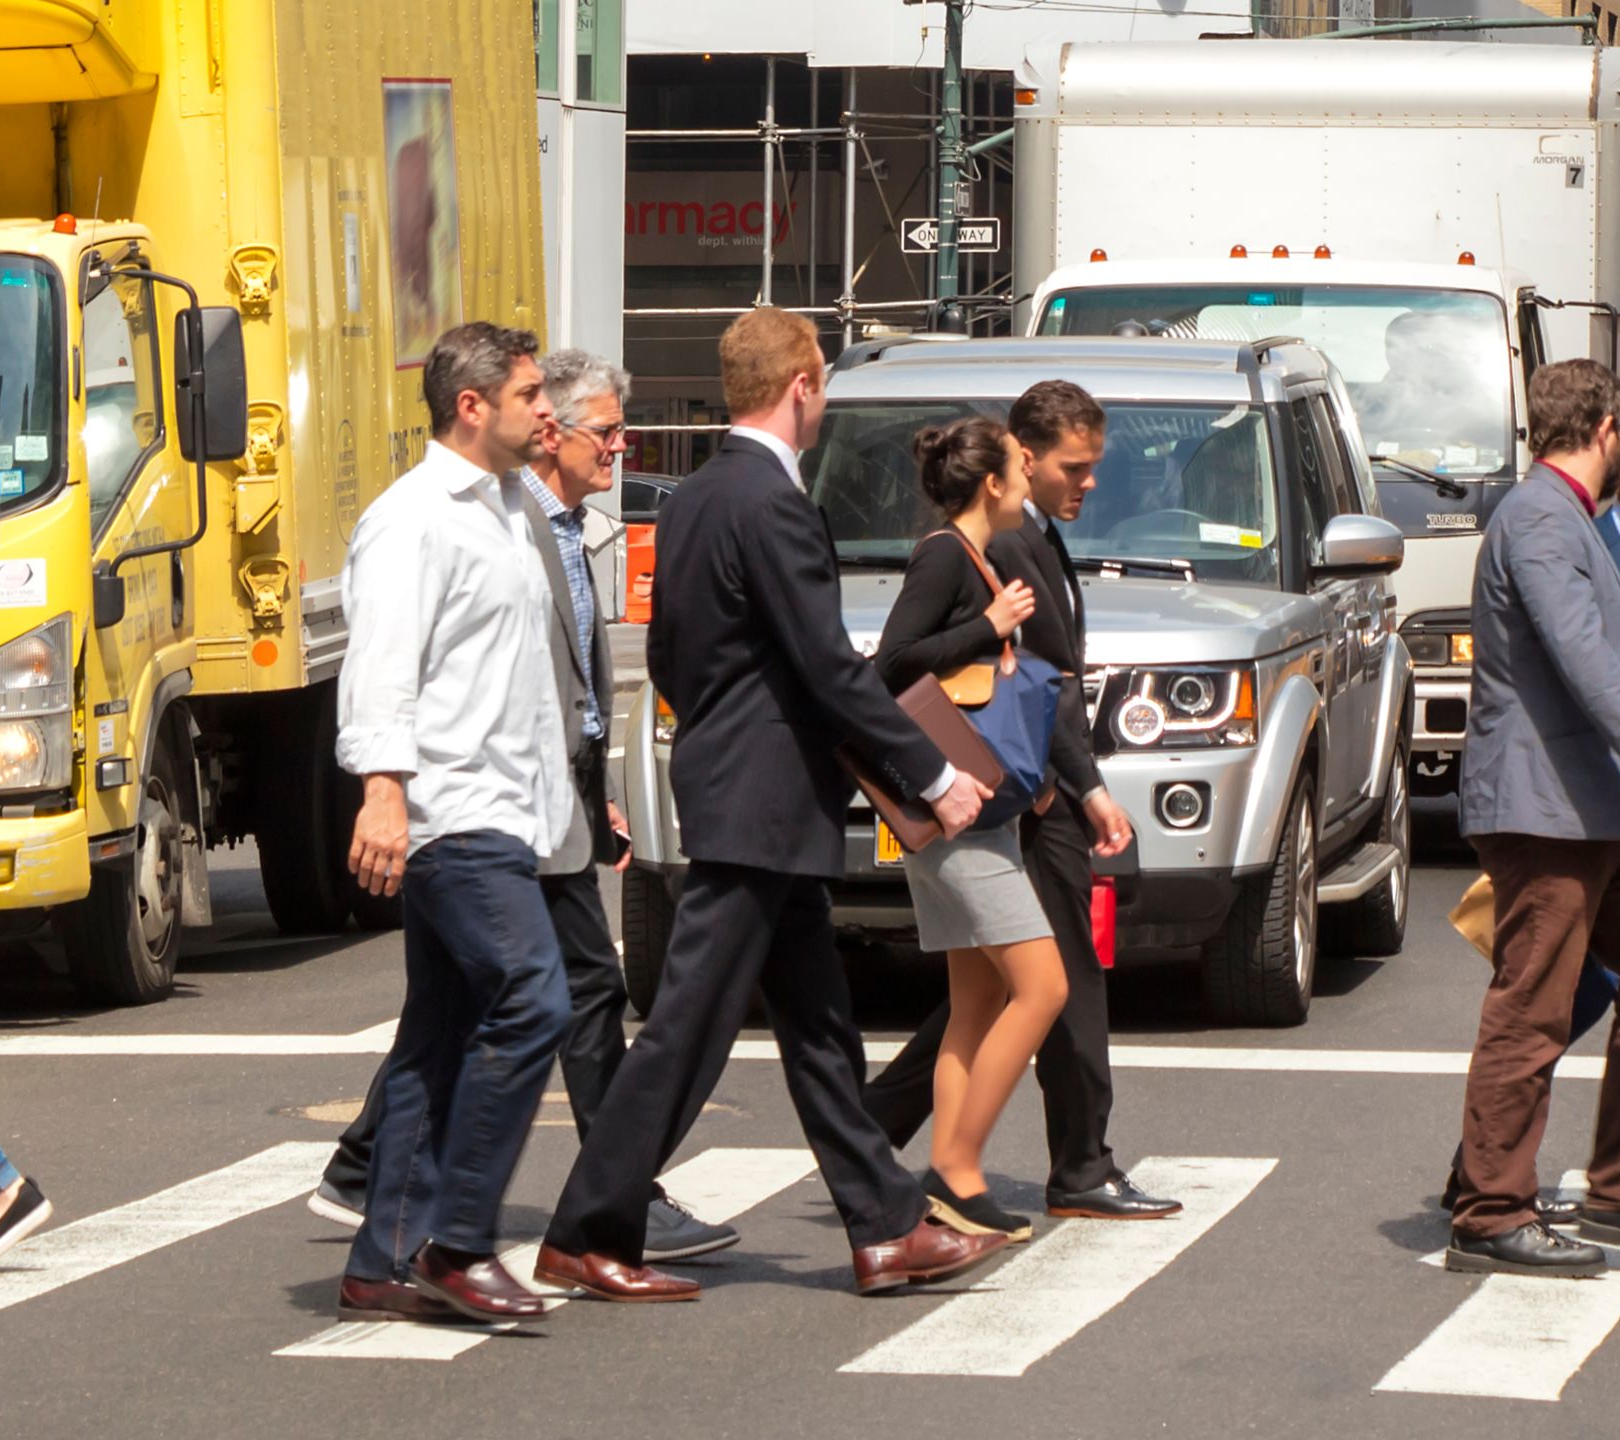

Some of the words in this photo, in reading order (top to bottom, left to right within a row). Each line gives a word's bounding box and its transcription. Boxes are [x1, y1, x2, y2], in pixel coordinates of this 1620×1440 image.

[625, 200, 797, 245] rmacy
[698, 235, 728, 248] dept.
[918, 229, 936, 241] ON
[957, 229, 987, 241] WAY
[1426, 514, 1477, 527] TURBO
